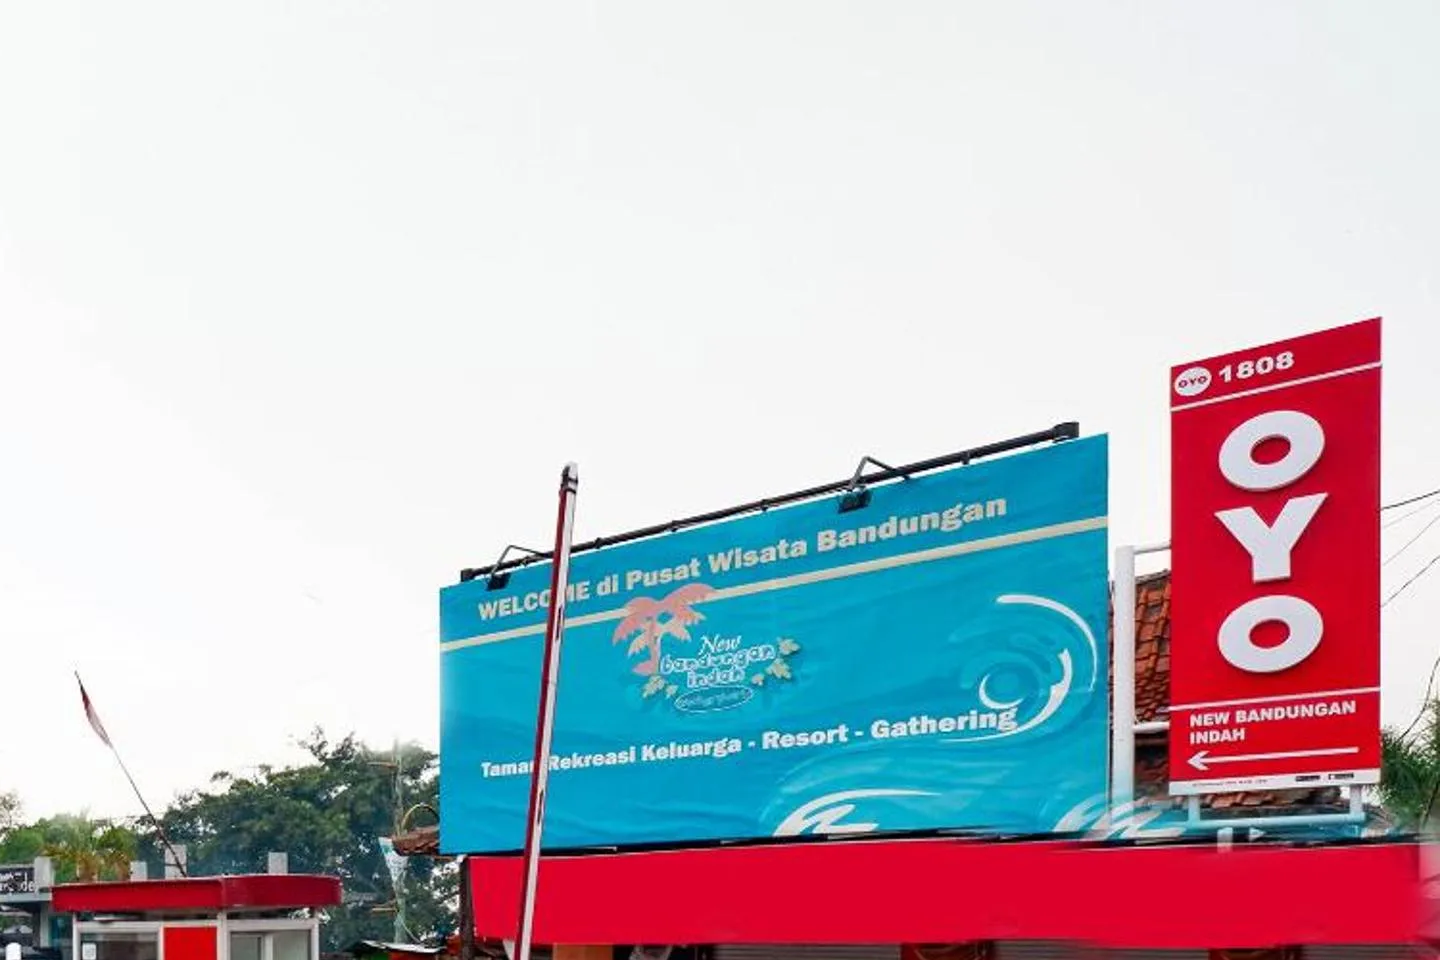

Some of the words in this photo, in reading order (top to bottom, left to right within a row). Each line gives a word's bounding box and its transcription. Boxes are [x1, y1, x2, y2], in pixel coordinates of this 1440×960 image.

[1178, 376, 1208, 389] OYO
[1219, 351, 1295, 383] 1808
[596, 574, 619, 597] di
[626, 559, 701, 591] Pusat
[708, 539, 808, 574] Wisata
[817, 498, 1007, 552] Bandungan
[1214, 410, 1329, 673] OYO
[698, 634, 742, 655] New
[1190, 711, 1230, 728] NEW
[1235, 700, 1357, 724] BANDUNGAN
[481, 759, 536, 778] Tama
[548, 746, 636, 771] Rekreasi
[641, 740, 743, 762] Keluarga
[762, 724, 849, 750] Resort
[870, 707, 1019, 739] Gathering
[1190, 728, 1246, 745] INDAH
